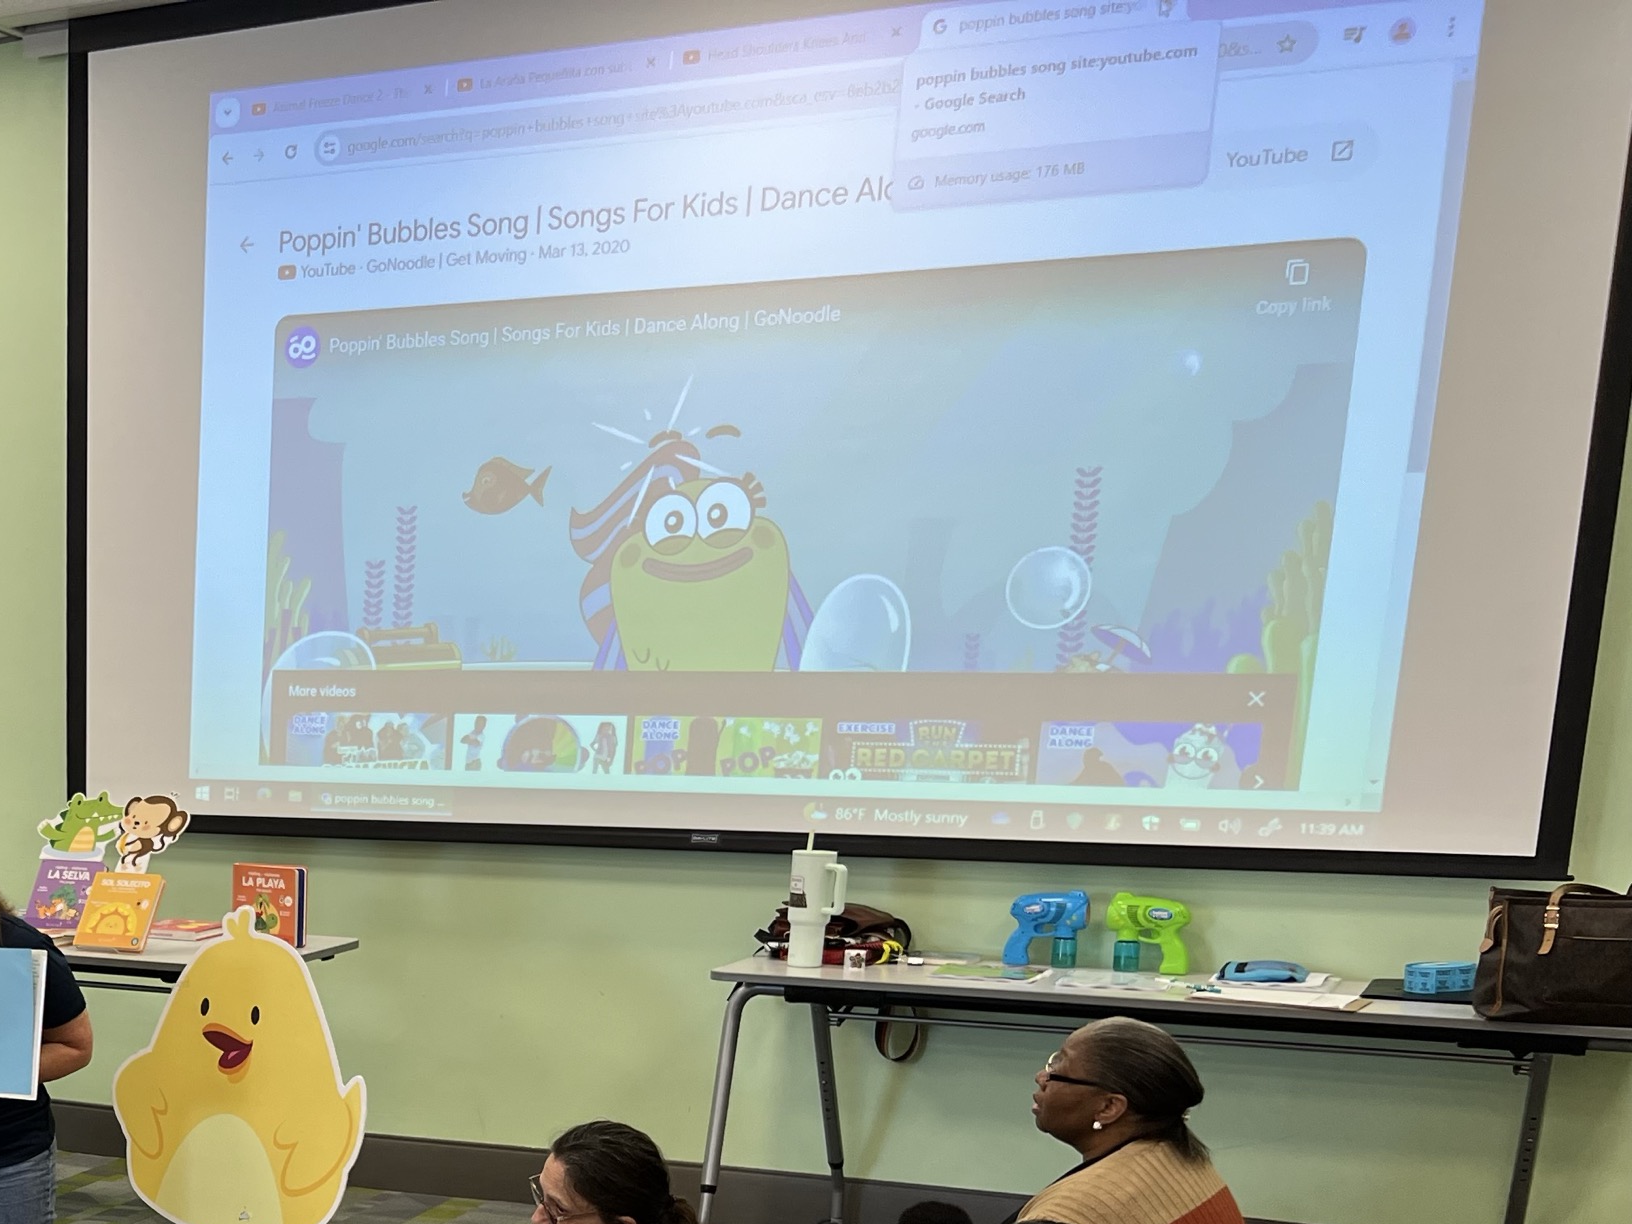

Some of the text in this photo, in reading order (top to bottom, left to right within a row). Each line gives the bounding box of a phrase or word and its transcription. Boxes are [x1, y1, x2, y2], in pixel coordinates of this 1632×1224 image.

[959, 14, 1005, 32] poppin
[1009, 7, 1060, 25] bubbles
[1064, 4, 1096, 21] song
[916, 46, 1198, 90] poppin bubbles song site:youtube.com
[923, 86, 1026, 112] Google Search
[911, 121, 985, 143] google.com
[1226, 146, 1308, 169] YouTube
[935, 169, 987, 189] Memory
[1063, 161, 1086, 176] MB
[279, 225, 362, 258] Poppin'
[367, 216, 462, 248] Bubbles
[466, 211, 529, 240] Song
[546, 203, 625, 232] Songs
[633, 197, 675, 224] For
[682, 190, 739, 220] Kids
[760, 184, 849, 213] Dance
[300, 262, 356, 280] YouTube
[366, 256, 435, 275] GoNoodle
[446, 250, 472, 267] Get
[475, 247, 527, 266] Moving
[538, 244, 567, 260] Mar
[591, 239, 630, 256] 2020
[1255, 296, 1333, 318] Copy link
[329, 336, 383, 357] Poppin'
[386, 331, 446, 351] Bubbles
[450, 328, 489, 348] Song
[501, 324, 551, 343] Songs
[555, 321, 582, 339] For
[585, 320, 621, 338] Kids
[633, 315, 686, 335] Dance
[689, 311, 739, 333] Along
[754, 305, 841, 327] GoNoodle
[288, 683, 355, 698] More videos
[293, 725, 326, 735] ALONG
[642, 720, 679, 730] DANCE
[838, 723, 895, 734] EXERCISE
[919, 726, 956, 740] RUN
[1049, 725, 1094, 737] DANCE
[642, 731, 679, 740] ALONG
[1049, 737, 1093, 748] ALONG
[857, 747, 1015, 770] RED CARPET
[334, 793, 435, 809] poppin bubbles song
[874, 807, 922, 827] Mostly
[925, 813, 969, 829] sunny
[1338, 823, 1364, 836] AM
[48, 869, 91, 881] LA SELVA
[242, 876, 286, 890] LA PLAYA
